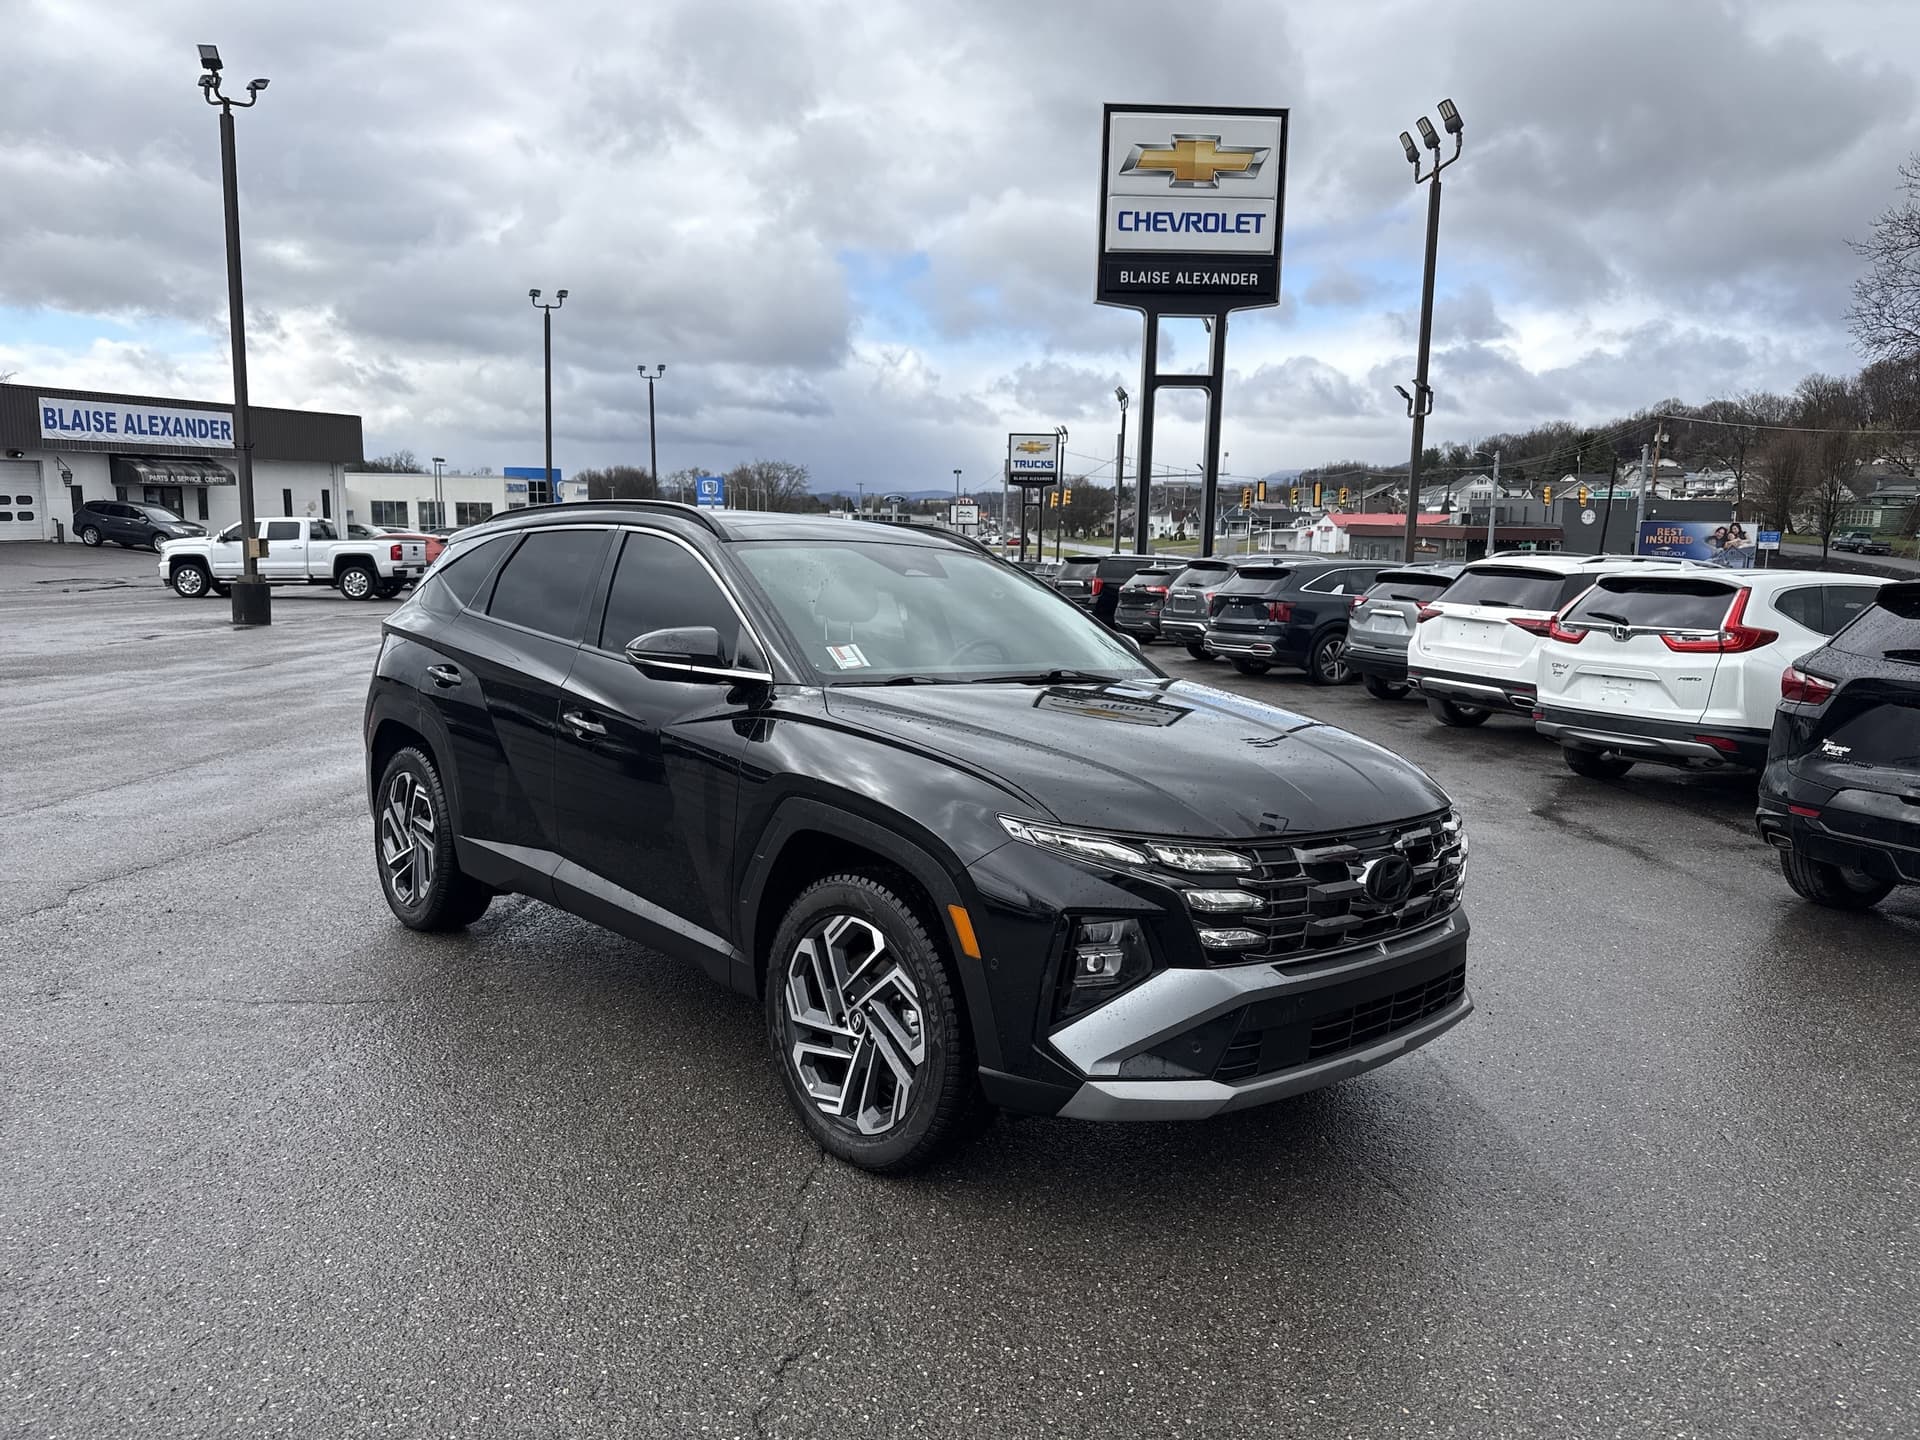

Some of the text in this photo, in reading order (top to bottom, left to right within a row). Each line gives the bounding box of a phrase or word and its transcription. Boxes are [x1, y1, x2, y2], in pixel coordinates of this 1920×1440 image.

[1118, 211, 1266, 233] CHEVROLET
[1120, 271, 1258, 285] BLAISE ALEXANDER
[43, 407, 232, 440] BLAISE ALEXANDER
[1013, 460, 1054, 468] TRUCKS
[149, 474, 169, 482] PARTS
[176, 475, 202, 483] SERVICE
[1657, 527, 1684, 536] REST
[1645, 535, 1694, 544] INSURED
